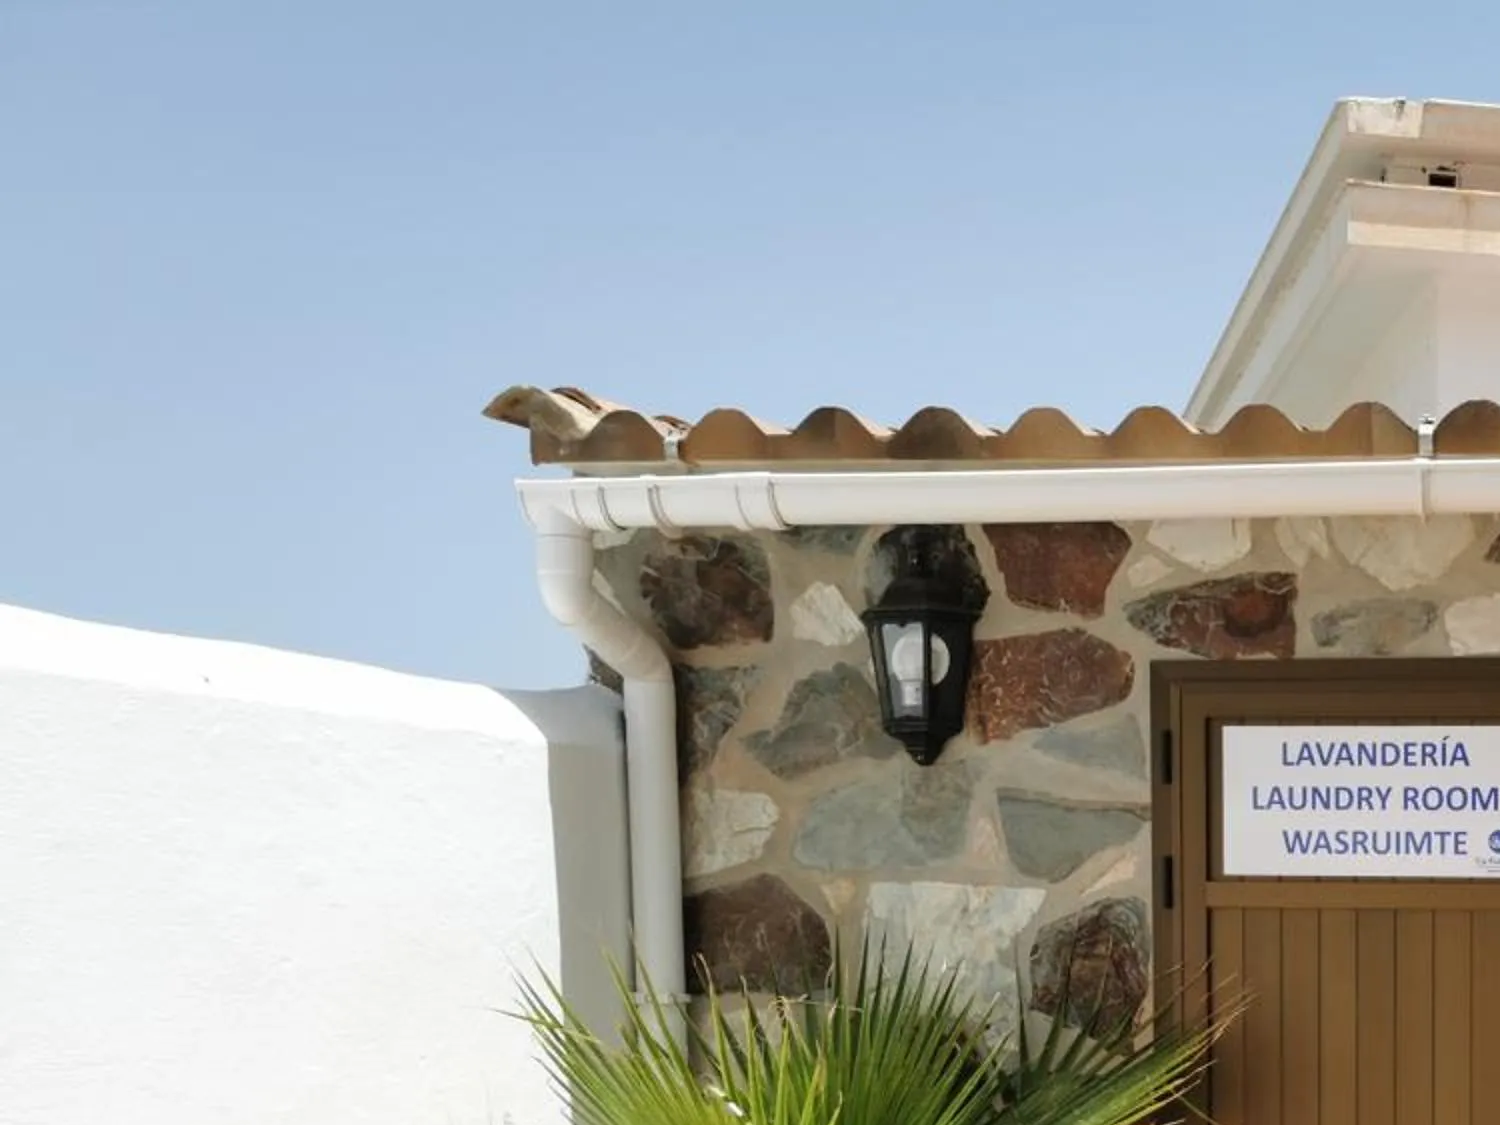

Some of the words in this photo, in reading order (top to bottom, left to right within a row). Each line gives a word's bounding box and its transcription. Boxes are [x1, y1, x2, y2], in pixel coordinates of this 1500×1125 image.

[1281, 735, 1470, 767] LAVANDERÍA
[1252, 785, 1393, 811] LAUNDRY
[1402, 785, 1500, 811] ROOM
[1283, 830, 1468, 855] WASRUIMTE
